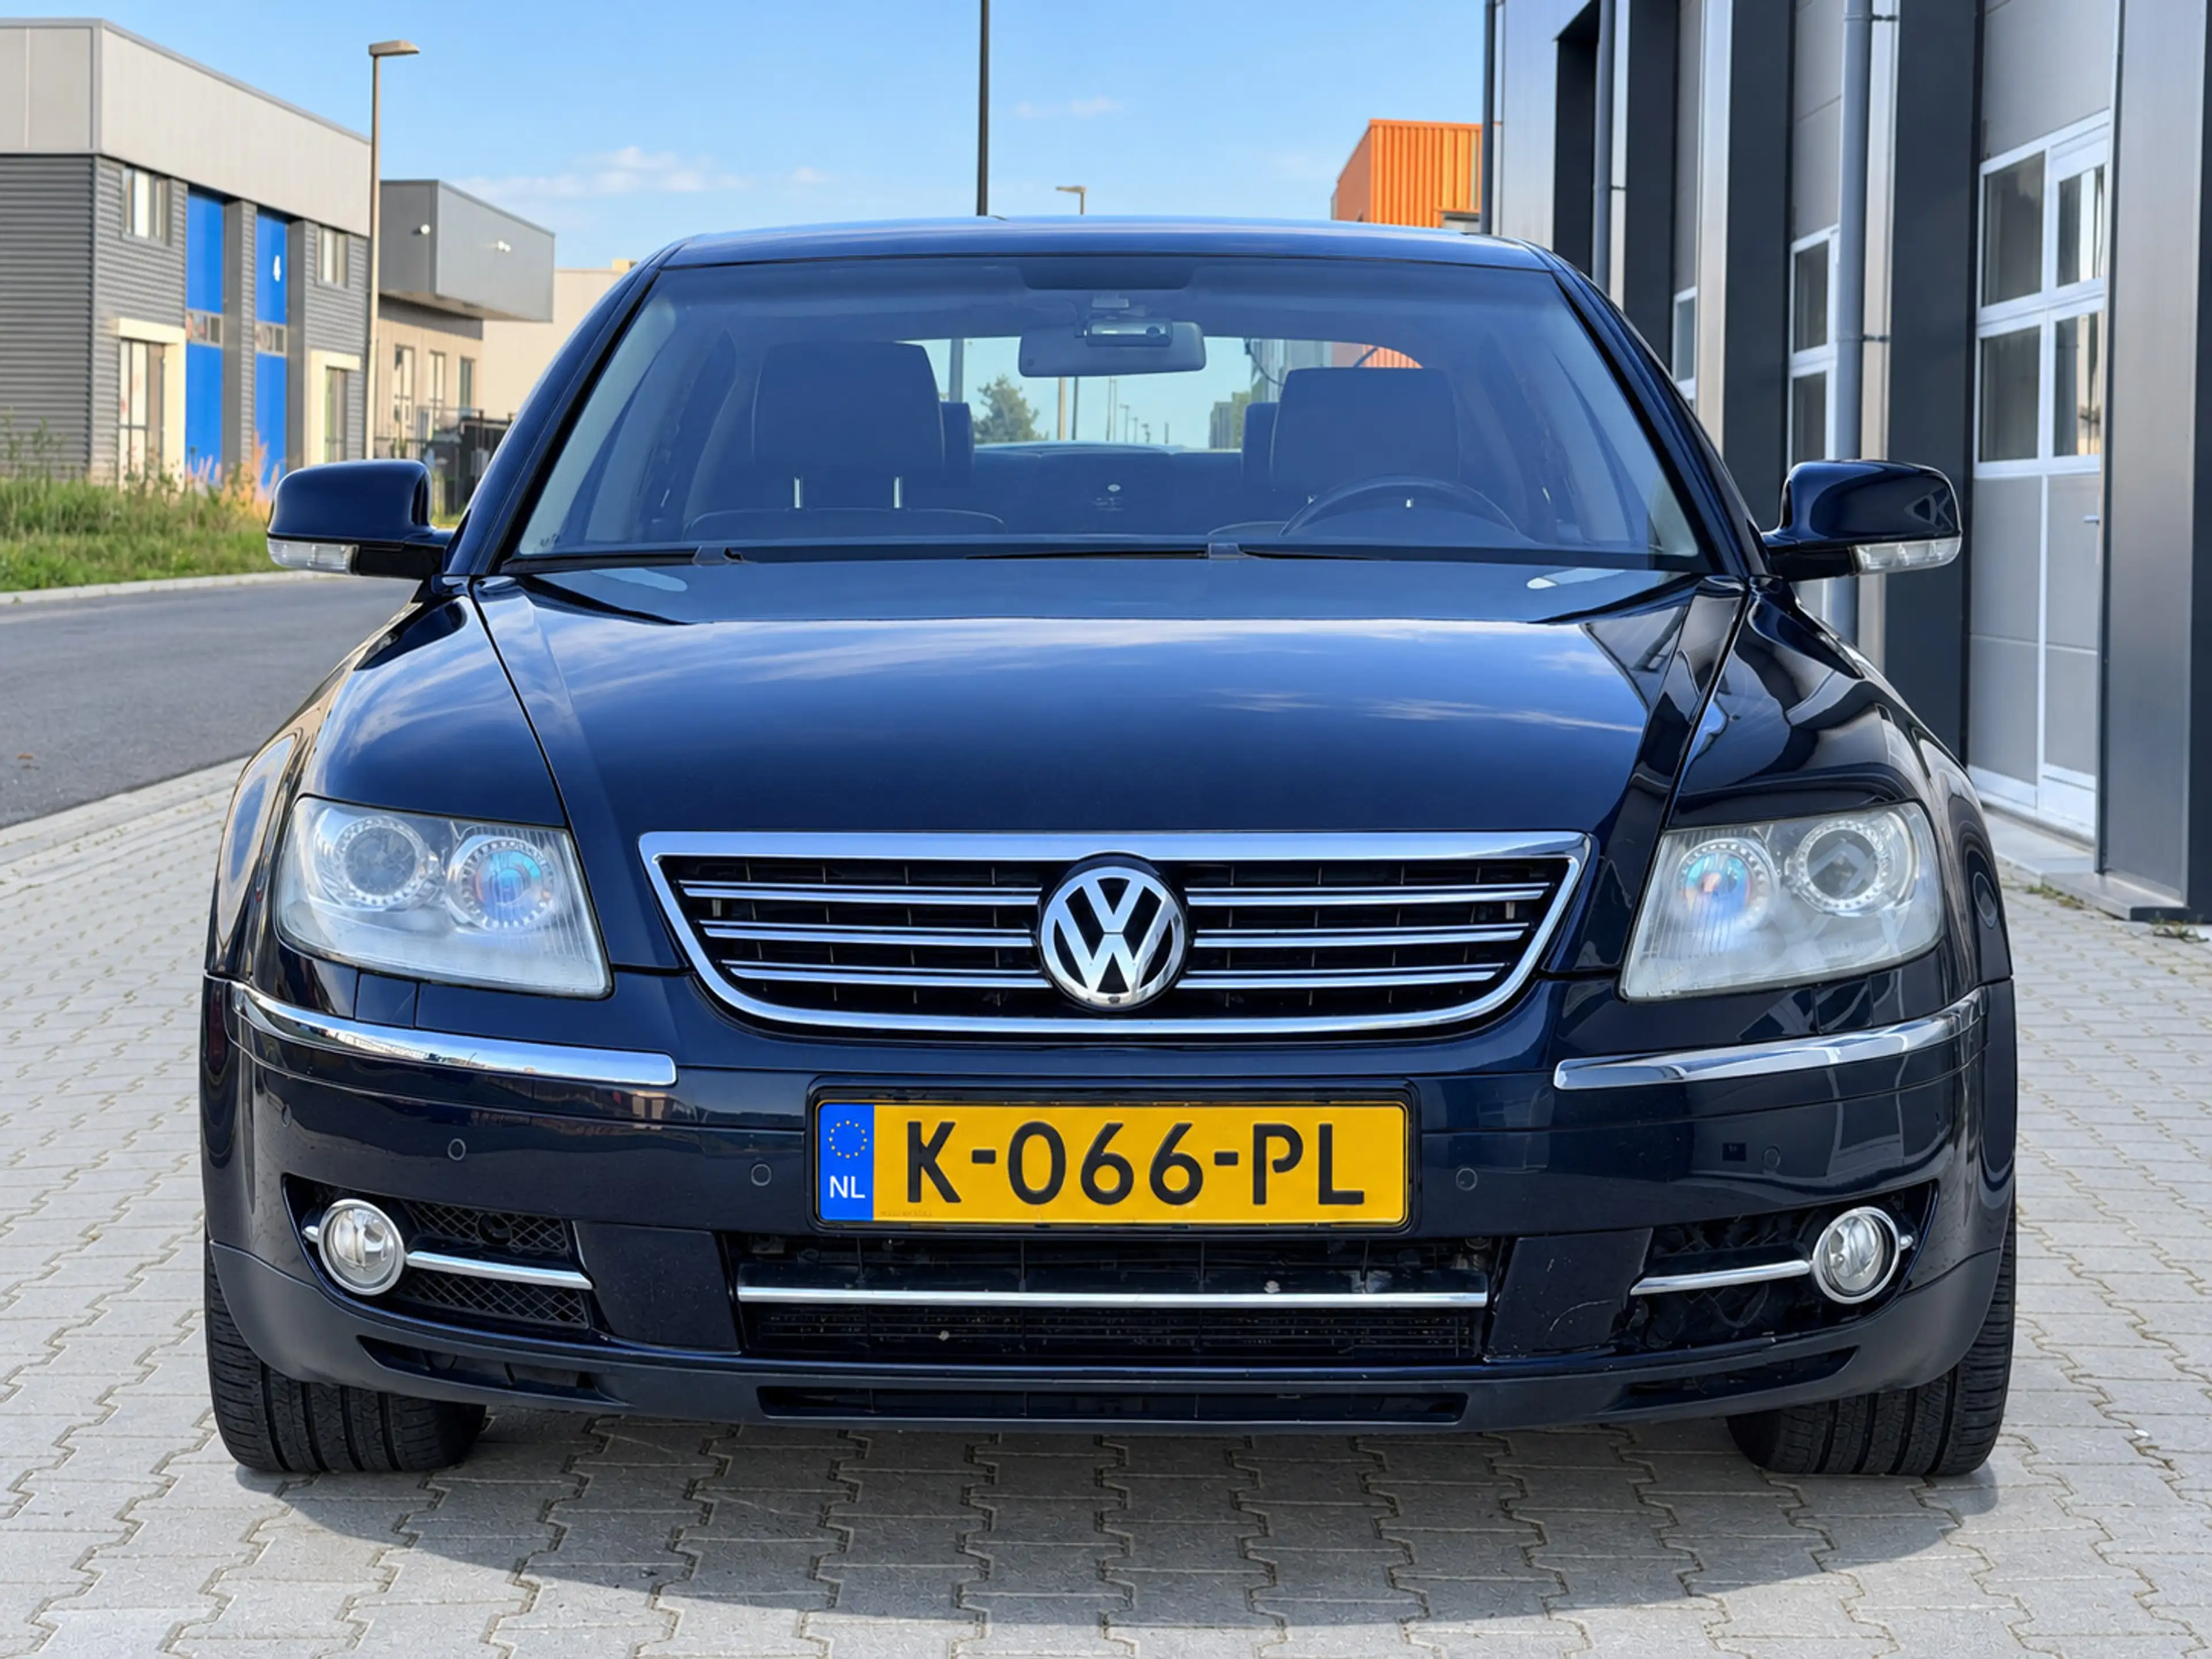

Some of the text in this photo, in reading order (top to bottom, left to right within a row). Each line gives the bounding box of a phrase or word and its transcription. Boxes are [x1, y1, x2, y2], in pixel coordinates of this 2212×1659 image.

[1044, 869, 1182, 1008] VW
[830, 1176, 865, 1198] NL
[907, 1121, 1365, 1206] K-066-PL
